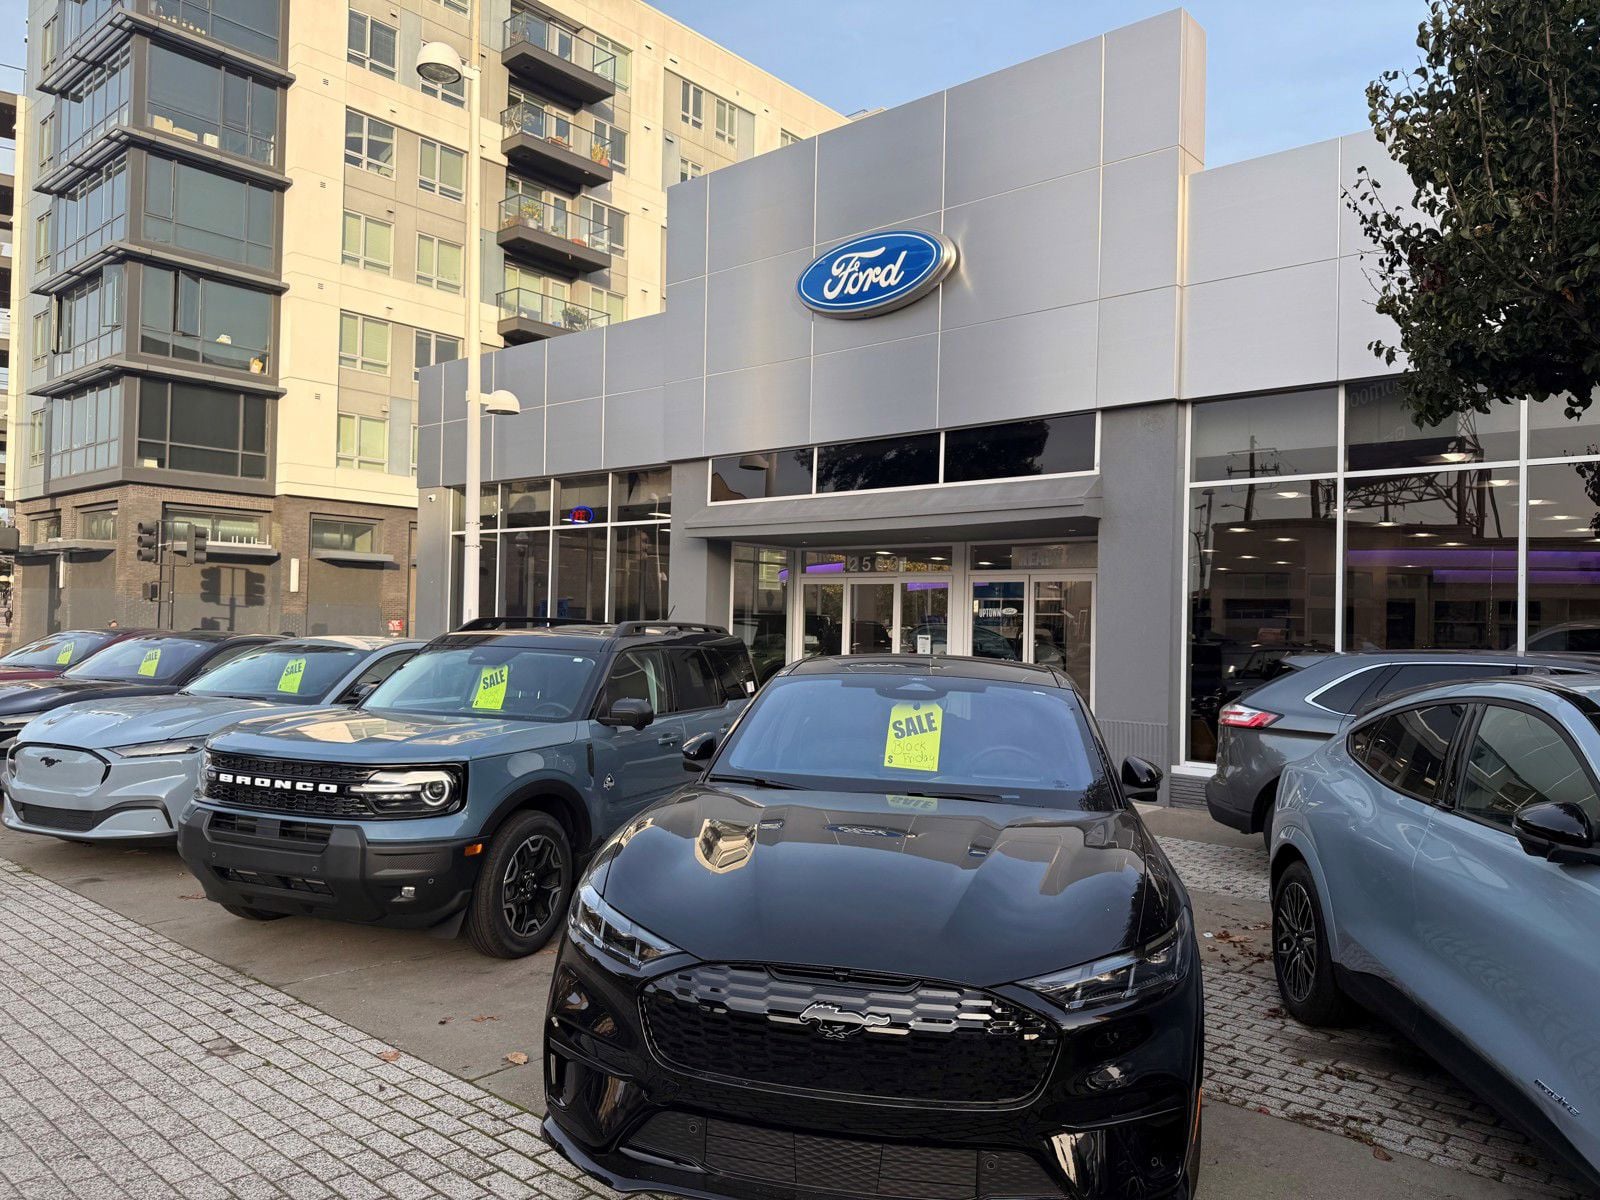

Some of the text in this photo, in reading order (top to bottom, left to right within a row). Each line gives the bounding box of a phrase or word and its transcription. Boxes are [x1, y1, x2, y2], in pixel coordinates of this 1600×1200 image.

[823, 246, 907, 300] Ford
[979, 607, 1002, 618] UPTOWN
[285, 663, 303, 676] SALE
[483, 669, 505, 689] SALE
[892, 712, 937, 739] SALE
[888, 755, 894, 763] $
[219, 773, 338, 793] BRONCO
